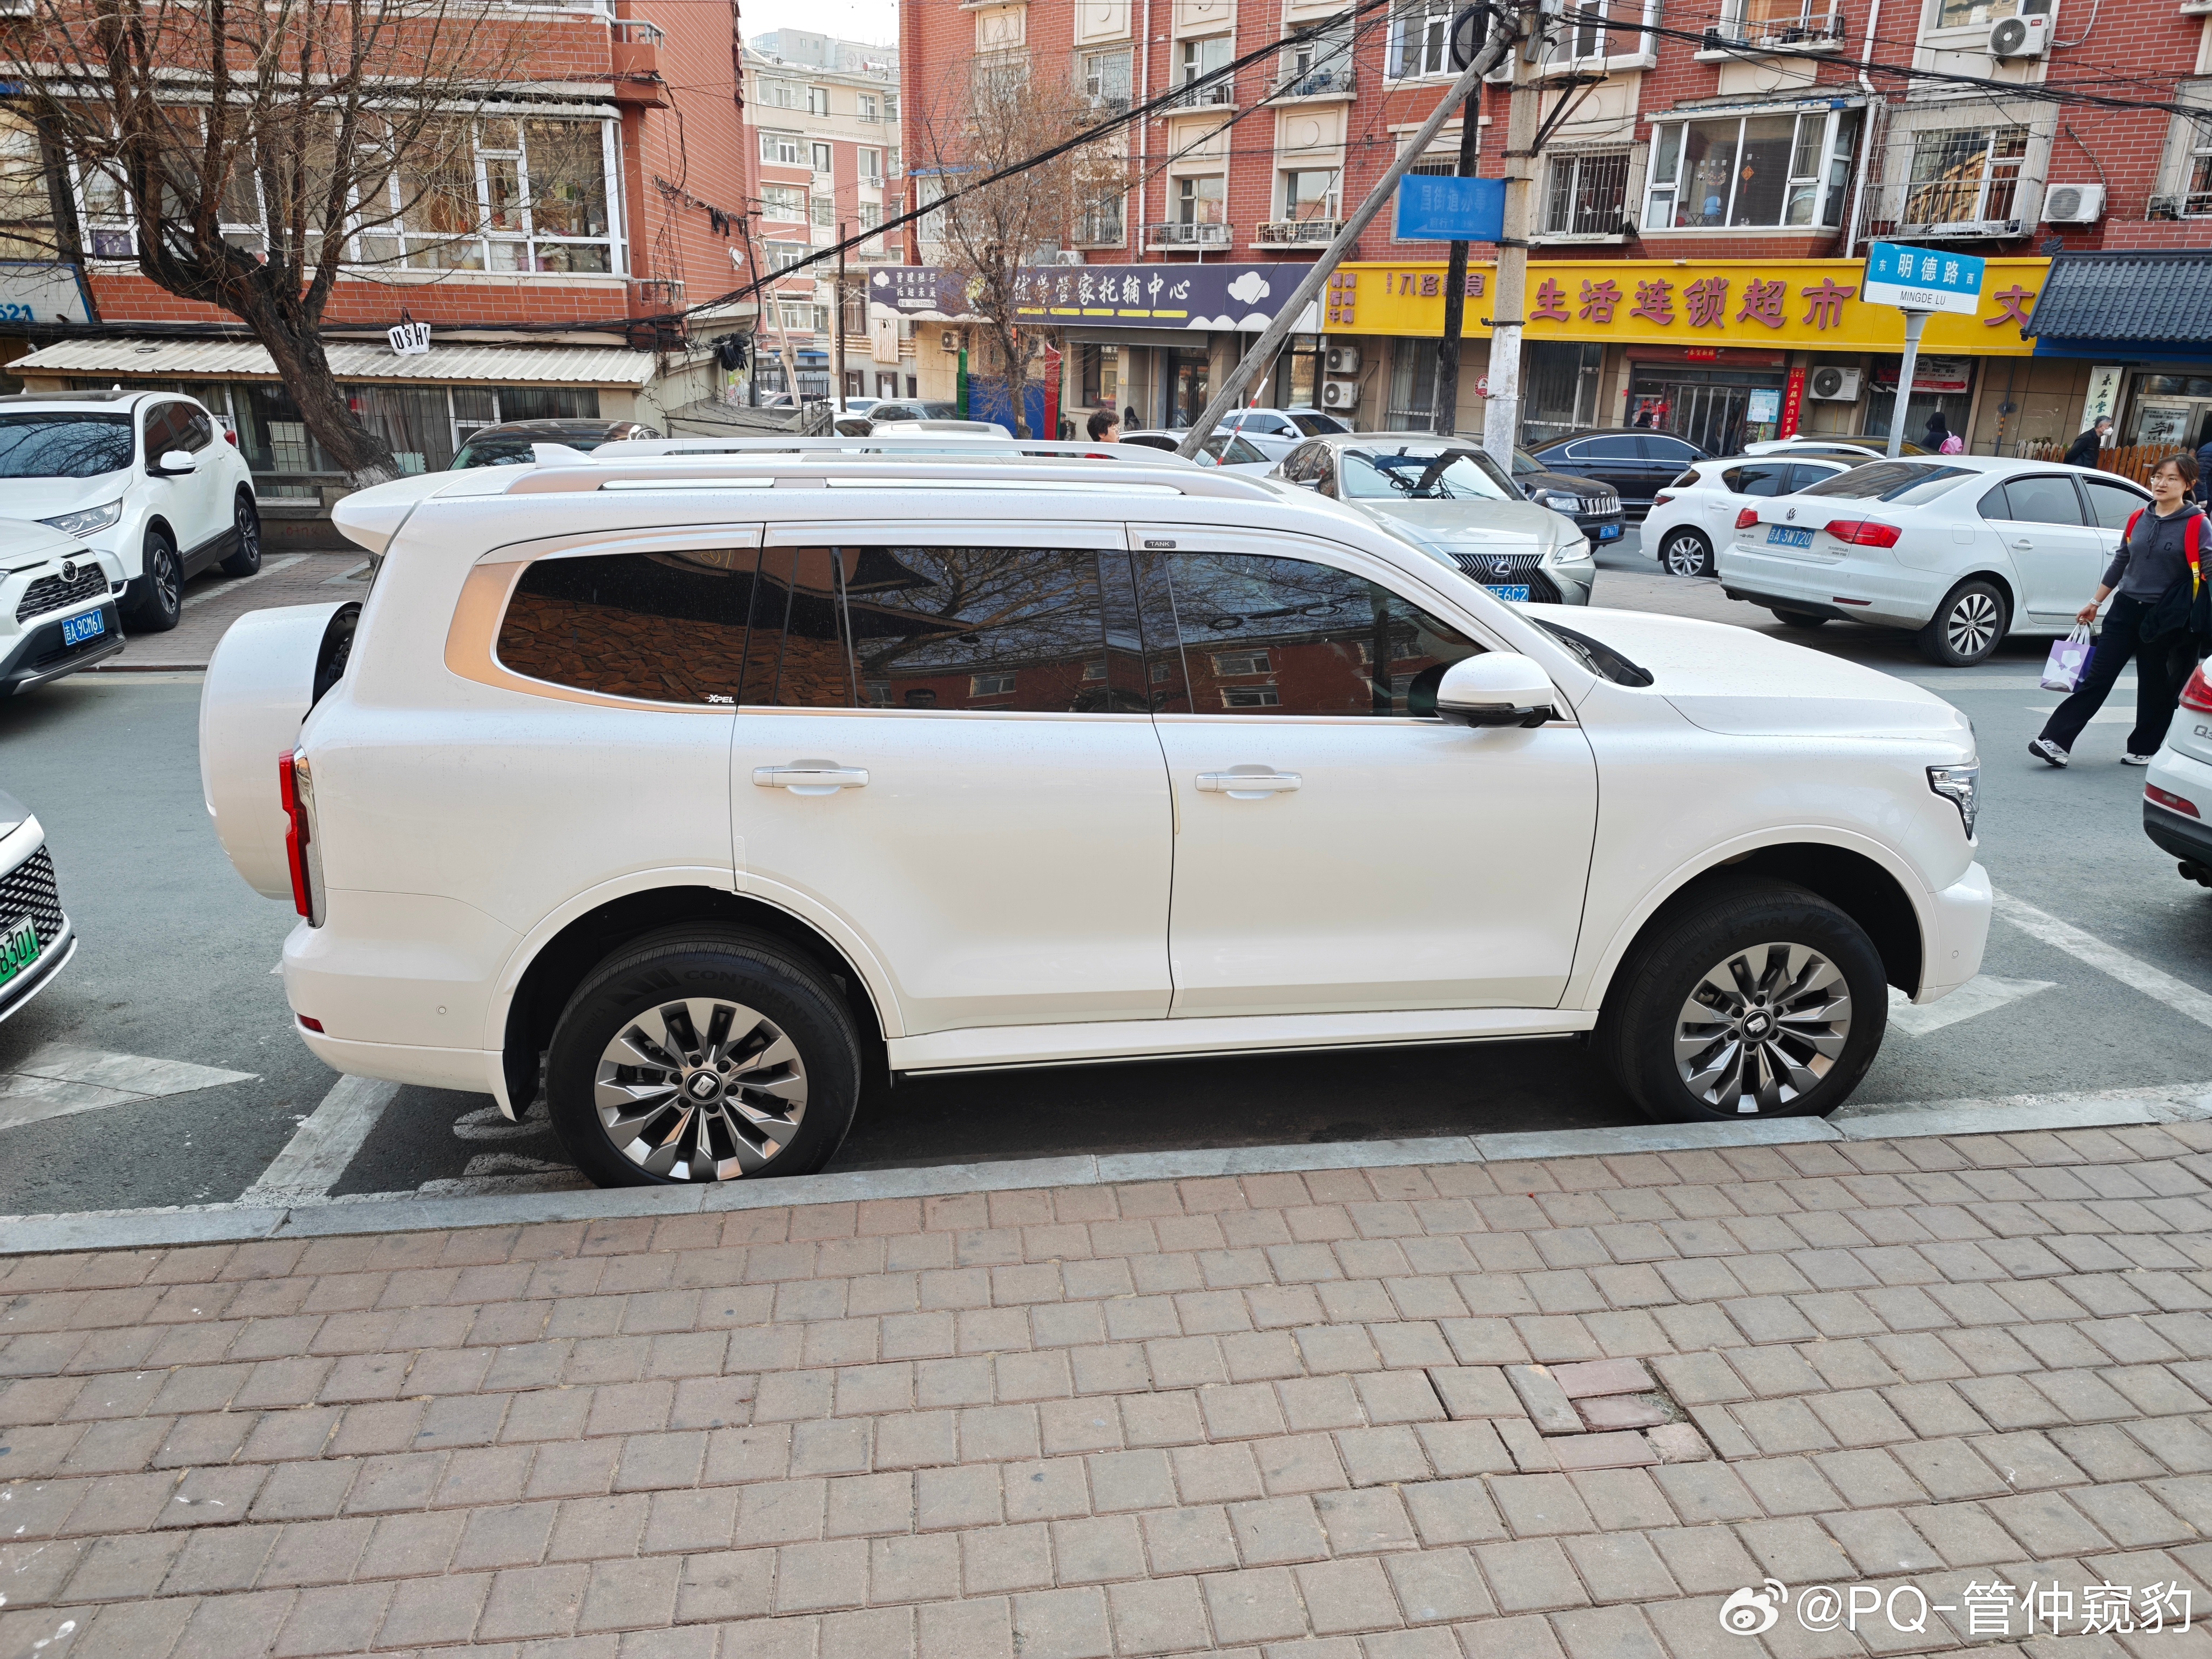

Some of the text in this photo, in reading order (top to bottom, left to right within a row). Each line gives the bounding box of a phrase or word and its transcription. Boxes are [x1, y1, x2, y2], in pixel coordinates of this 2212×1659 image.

[1878, 253, 1974, 285] 东 明德路 西
[896, 287, 936, 297] 托起未来
[1399, 273, 1486, 296] 八珍食
[1529, 276, 2034, 330] 生活连锁超市 文
[1900, 291, 1946, 305] MINGDE LU
[707, 694, 734, 703] XPEL
